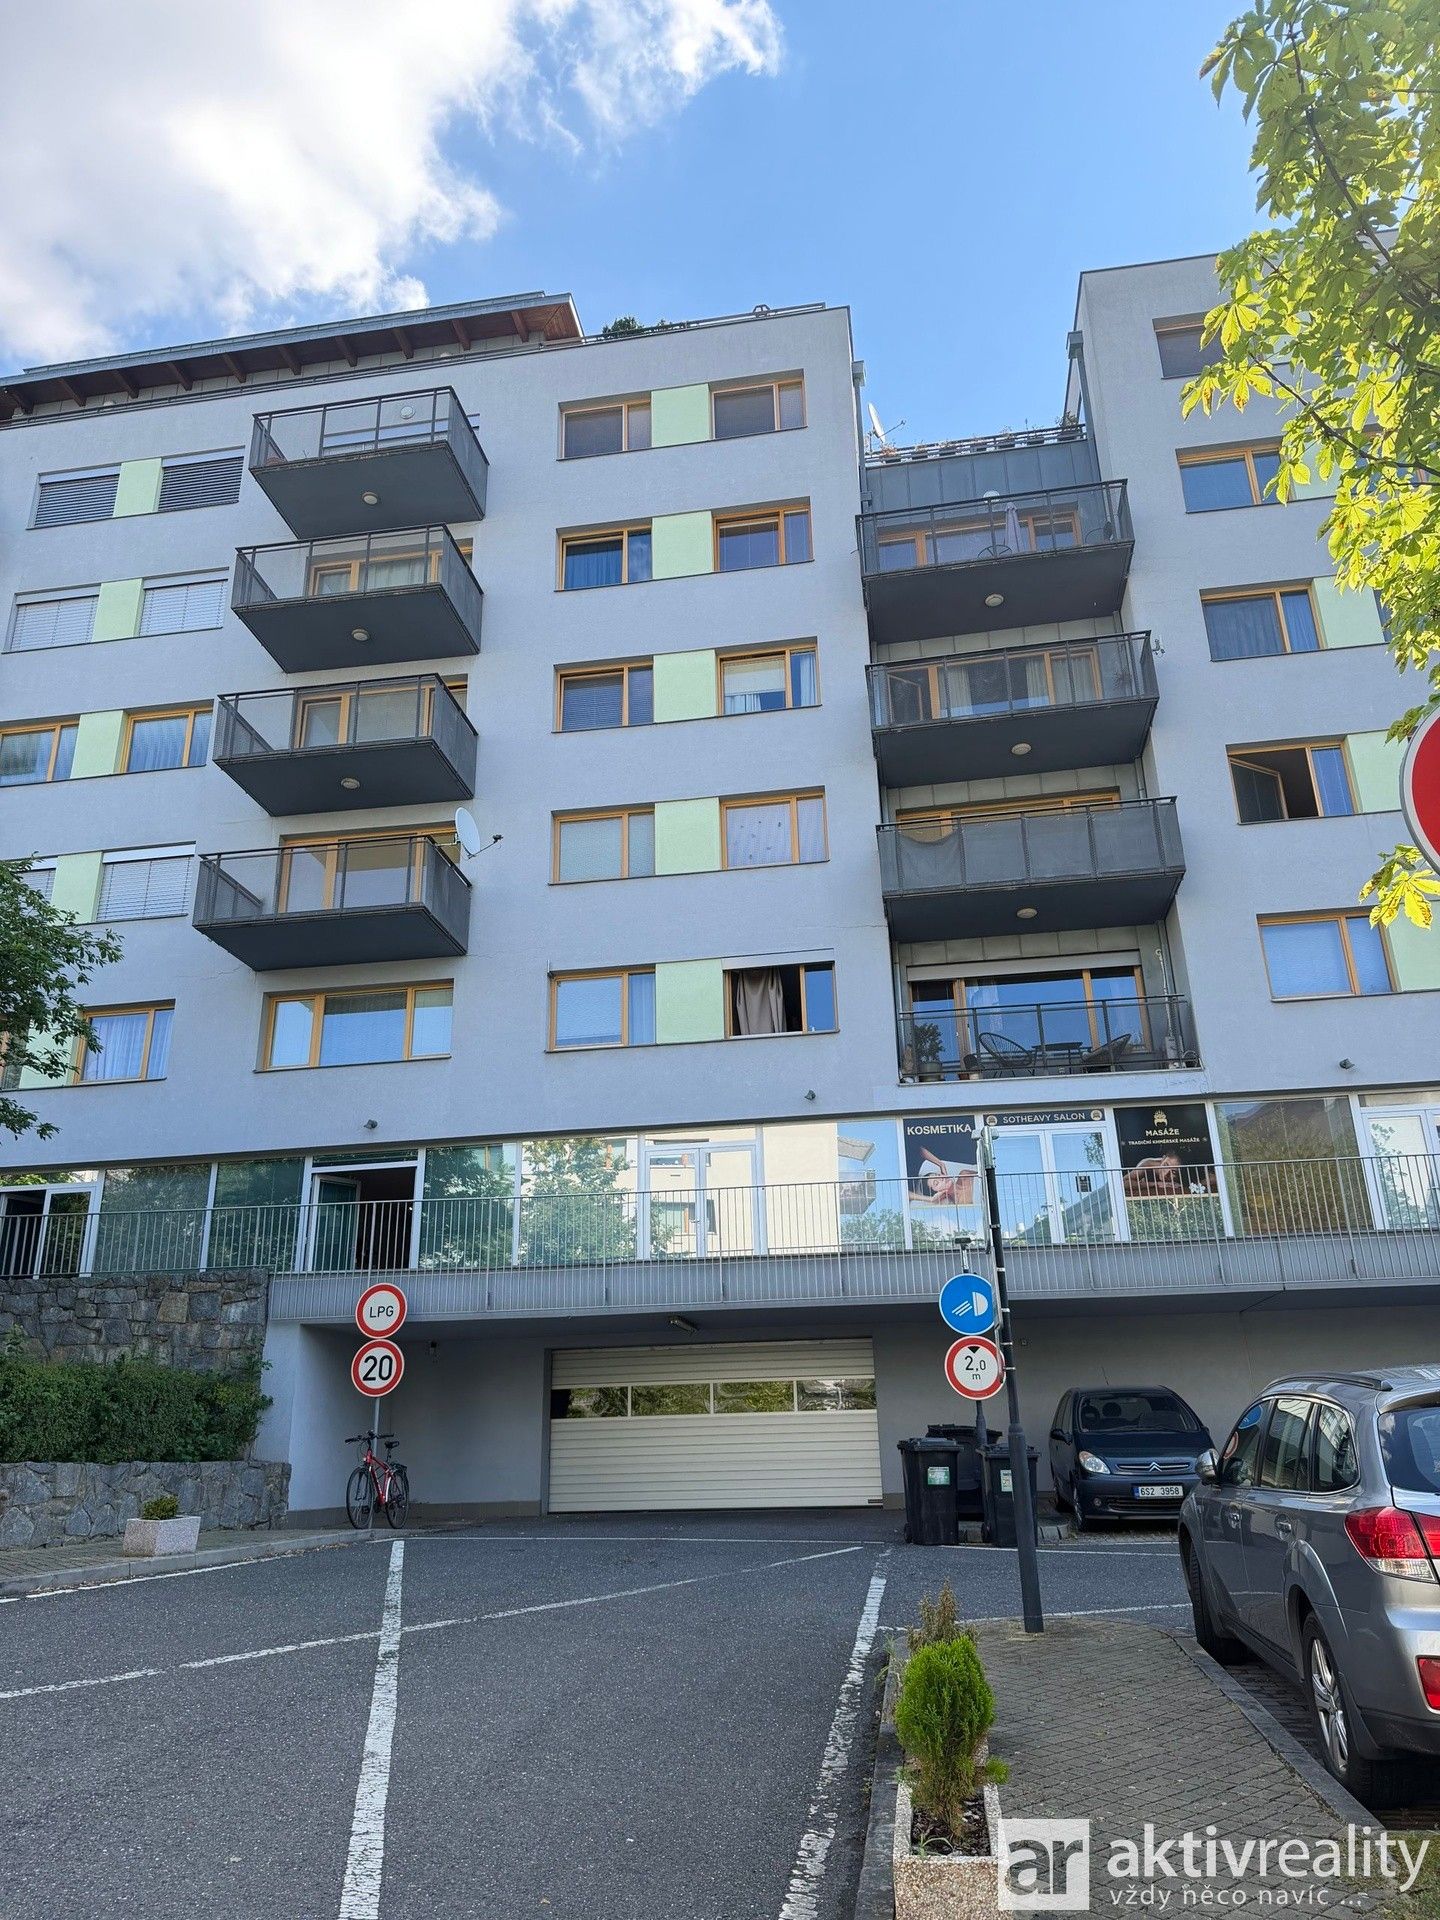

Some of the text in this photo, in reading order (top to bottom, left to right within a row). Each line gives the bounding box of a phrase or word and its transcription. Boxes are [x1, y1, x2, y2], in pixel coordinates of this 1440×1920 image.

[1003, 1112, 1086, 1124] SOTHEAVY SALON
[907, 1123, 972, 1135] KOSMETIKA
[1145, 1127, 1180, 1137] MASÁŽE
[369, 1305, 394, 1318] LPG
[362, 1355, 393, 1381] 20
[1140, 1486, 1180, 1496] 6S2 3958
